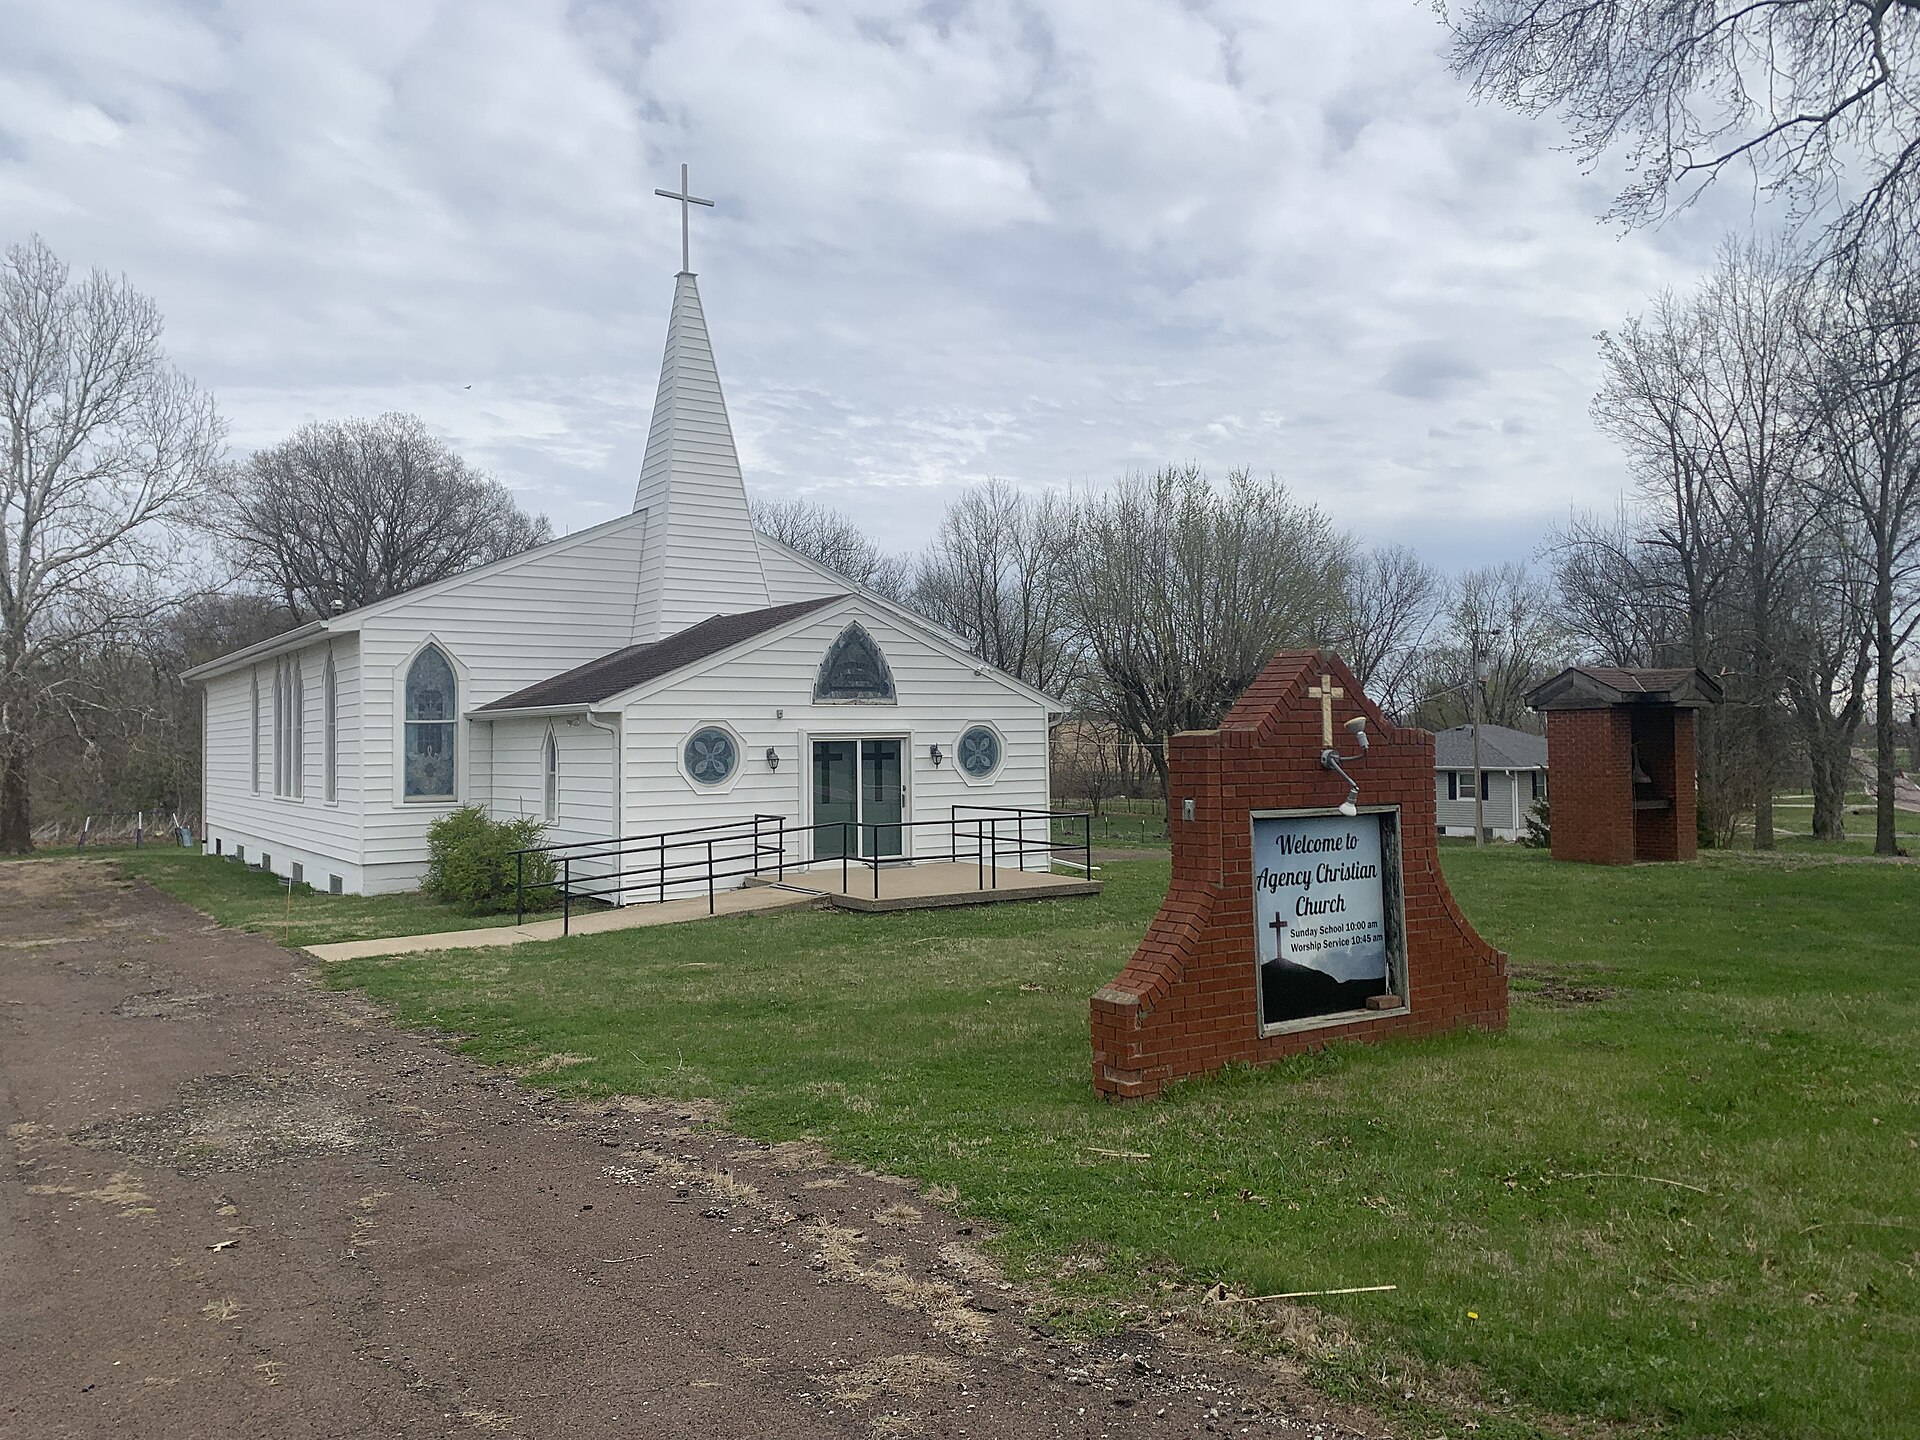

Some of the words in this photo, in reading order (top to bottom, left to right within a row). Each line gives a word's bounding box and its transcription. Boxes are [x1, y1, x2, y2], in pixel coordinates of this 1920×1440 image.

[1276, 834, 1343, 855] Welcome
[1346, 833, 1359, 850] to
[1257, 867, 1312, 894] Agency
[1316, 861, 1377, 883] Christian
[1296, 894, 1346, 917] Church
[1290, 927, 1317, 938] Sunday
[1319, 924, 1344, 935] School
[1346, 921, 1366, 932] 10:00
[1367, 921, 1378, 929] am
[1290, 941, 1322, 953] Worship
[1323, 937, 1350, 949] Service
[1351, 934, 1372, 945] 10:45
[1372, 934, 1383, 942] am
